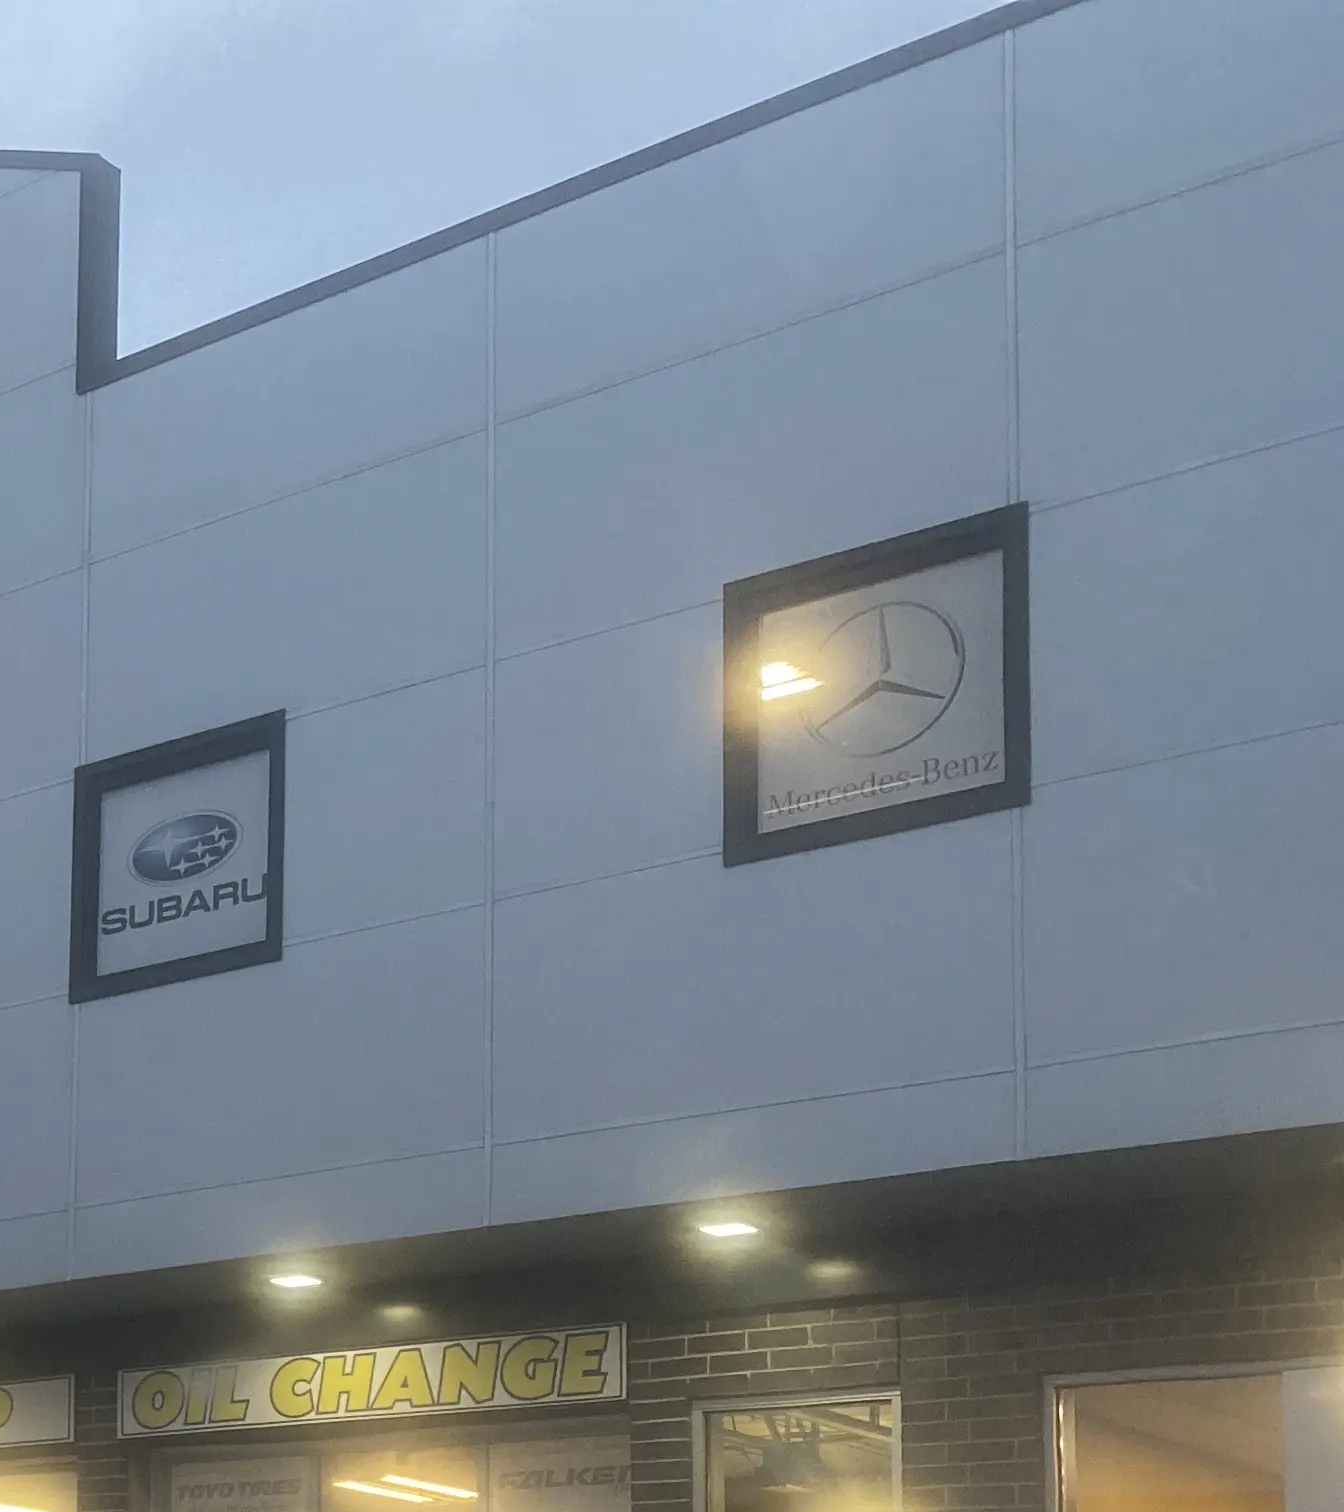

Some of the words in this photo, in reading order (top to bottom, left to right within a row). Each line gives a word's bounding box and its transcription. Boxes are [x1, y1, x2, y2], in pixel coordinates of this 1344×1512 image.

[766, 750, 999, 819] Mercedes-Benz
[101, 873, 267, 936] SUBARU
[131, 1364, 250, 1430] OIL
[269, 1331, 610, 1419] CHANGE
